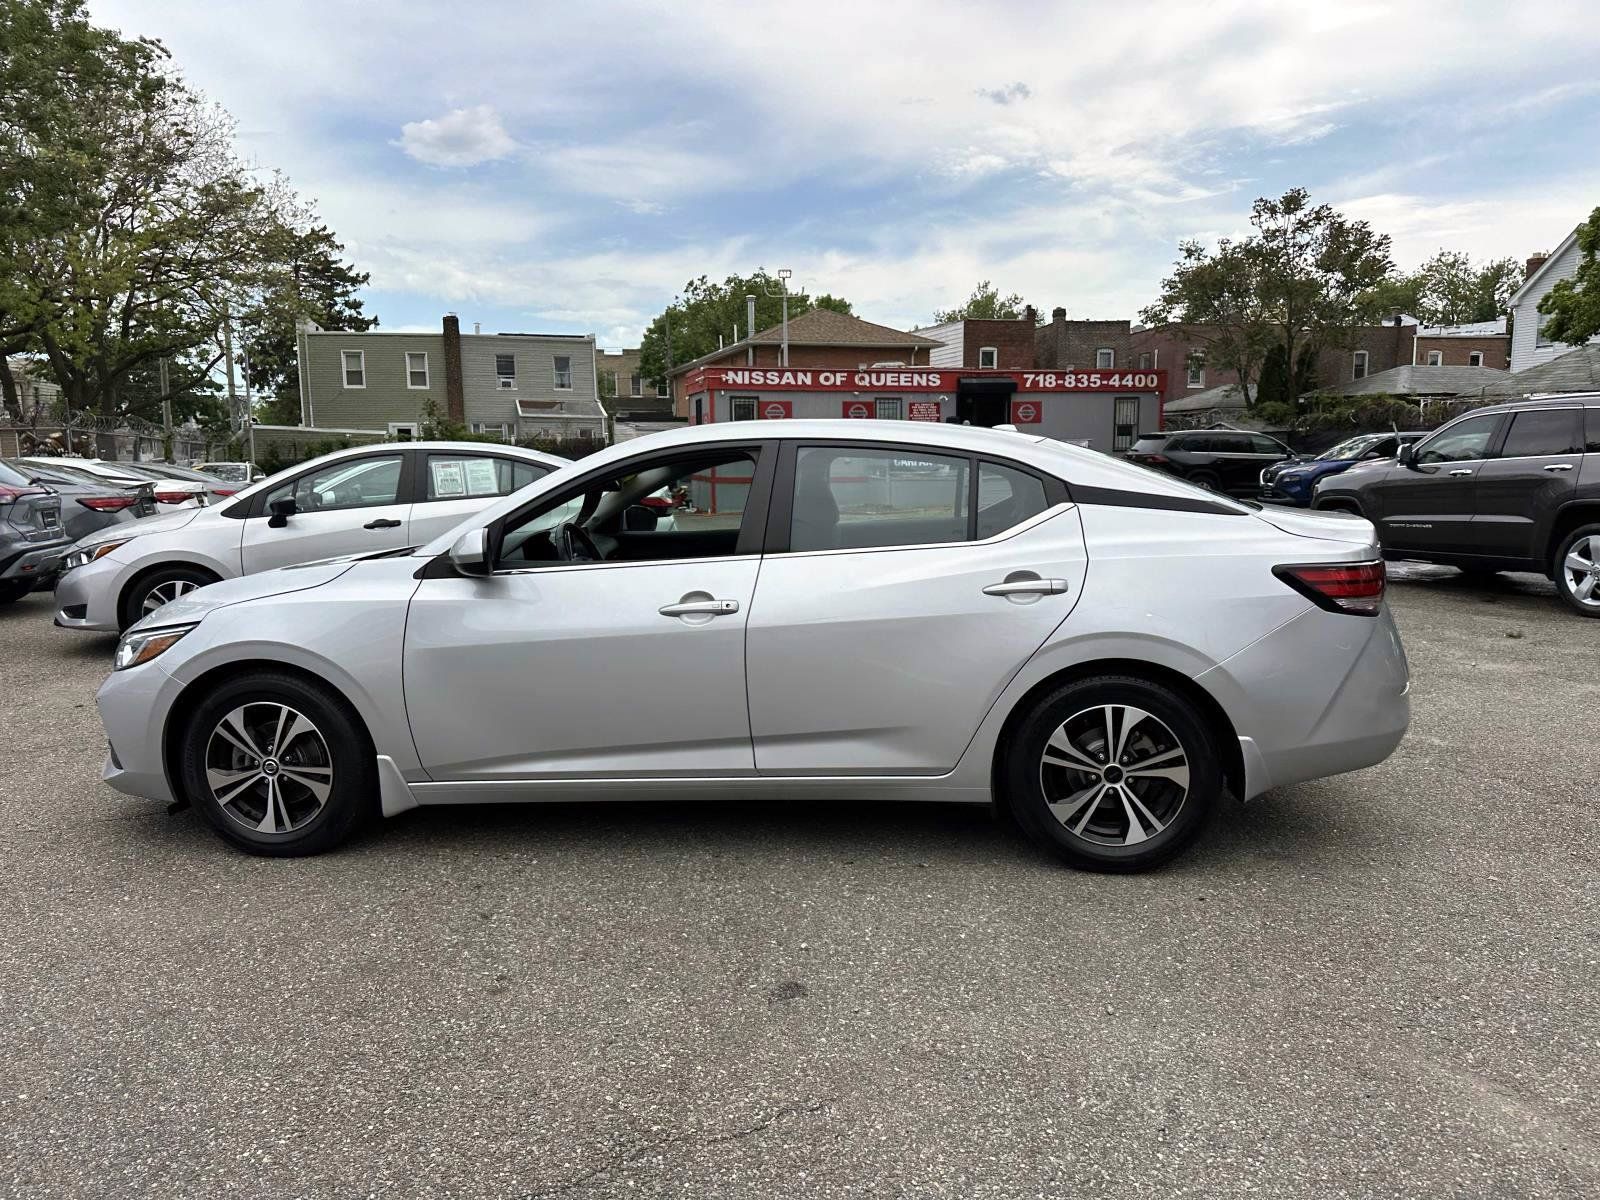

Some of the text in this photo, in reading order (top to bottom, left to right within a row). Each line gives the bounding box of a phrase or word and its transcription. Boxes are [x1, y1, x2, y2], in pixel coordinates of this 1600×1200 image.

[727, 370, 941, 387] NISSAN OF QUEENS
[1023, 373, 1158, 388] 718-835-4400
